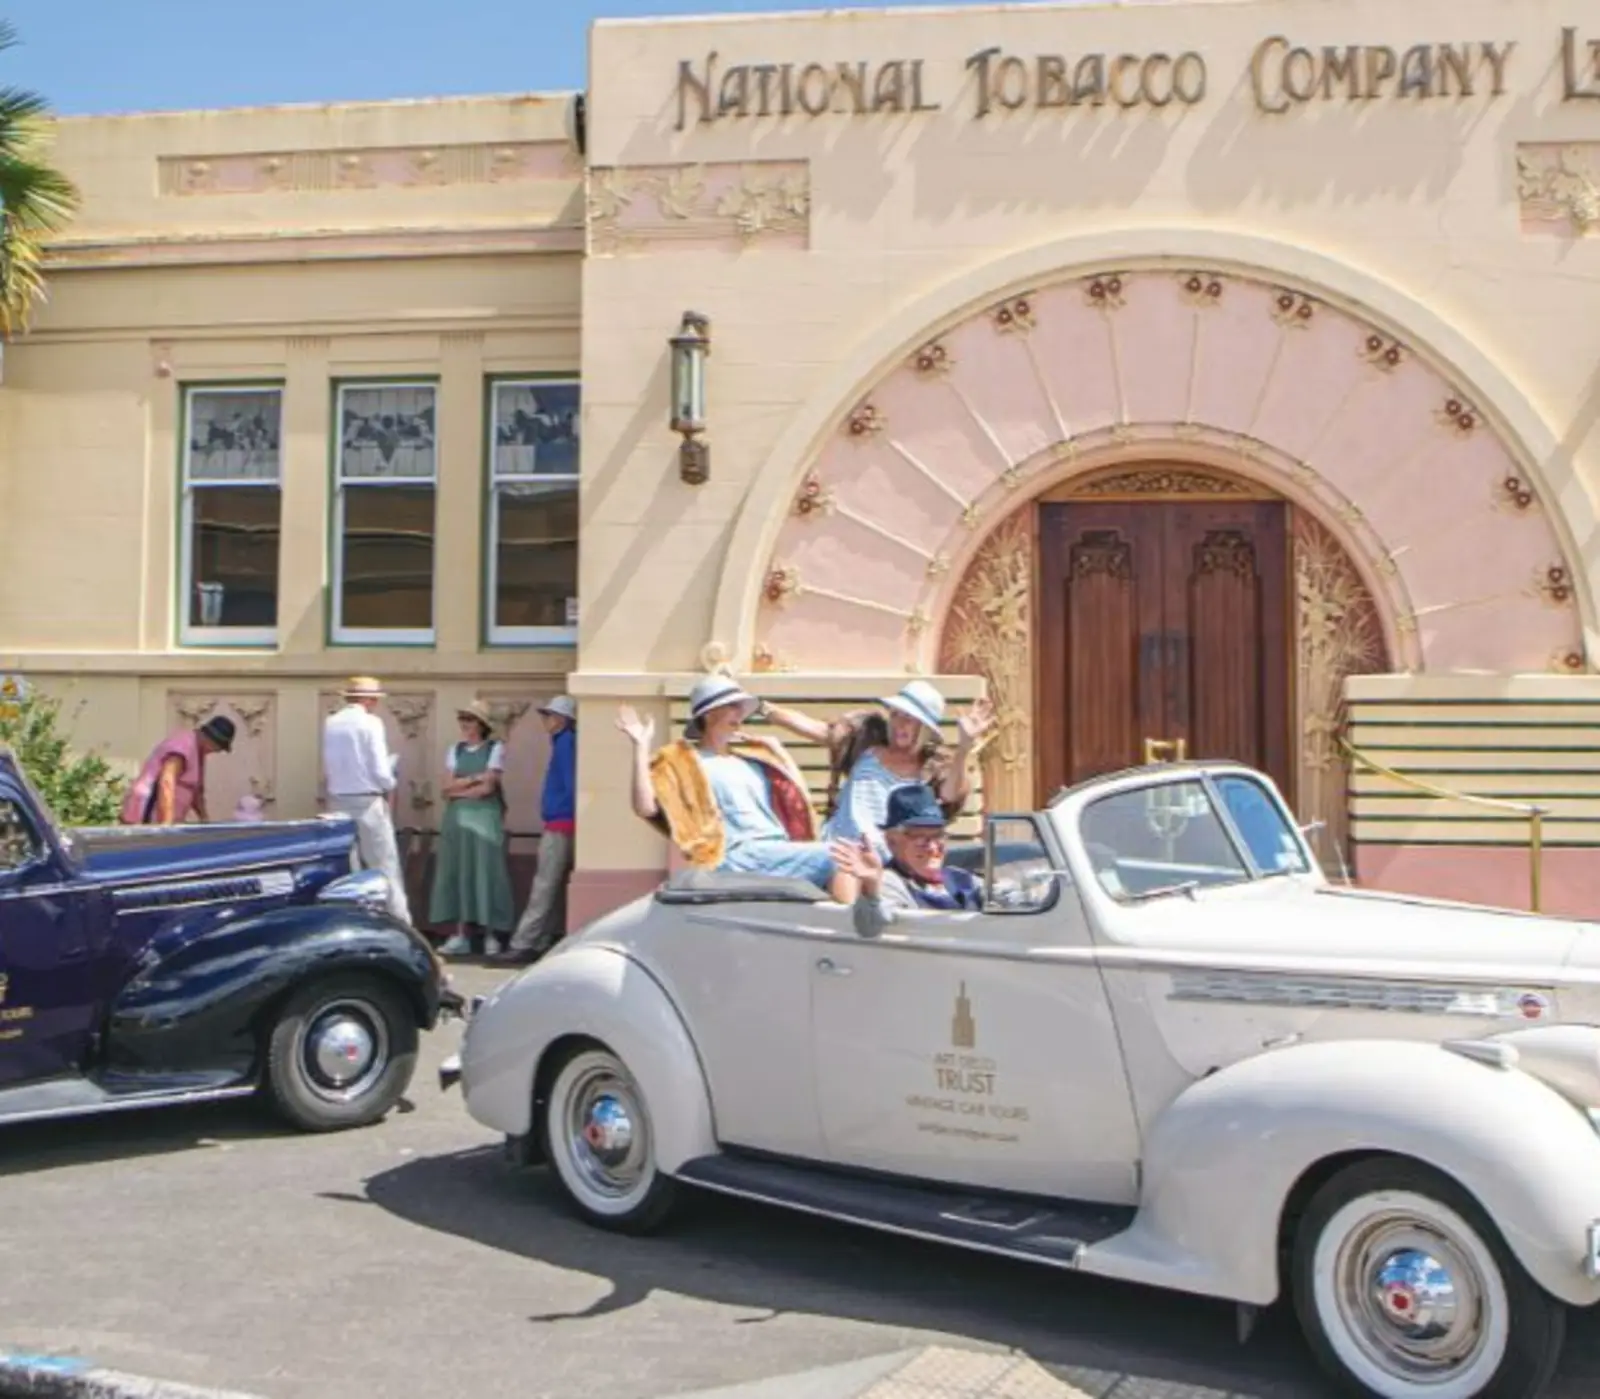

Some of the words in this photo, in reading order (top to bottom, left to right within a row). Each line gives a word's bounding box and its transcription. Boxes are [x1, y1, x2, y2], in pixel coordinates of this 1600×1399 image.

[674, 50, 941, 131] NATIONAL
[964, 46, 1207, 119] TOBACCO
[1251, 35, 1518, 114] COMPANY
[936, 1068, 995, 1096] TRUST
